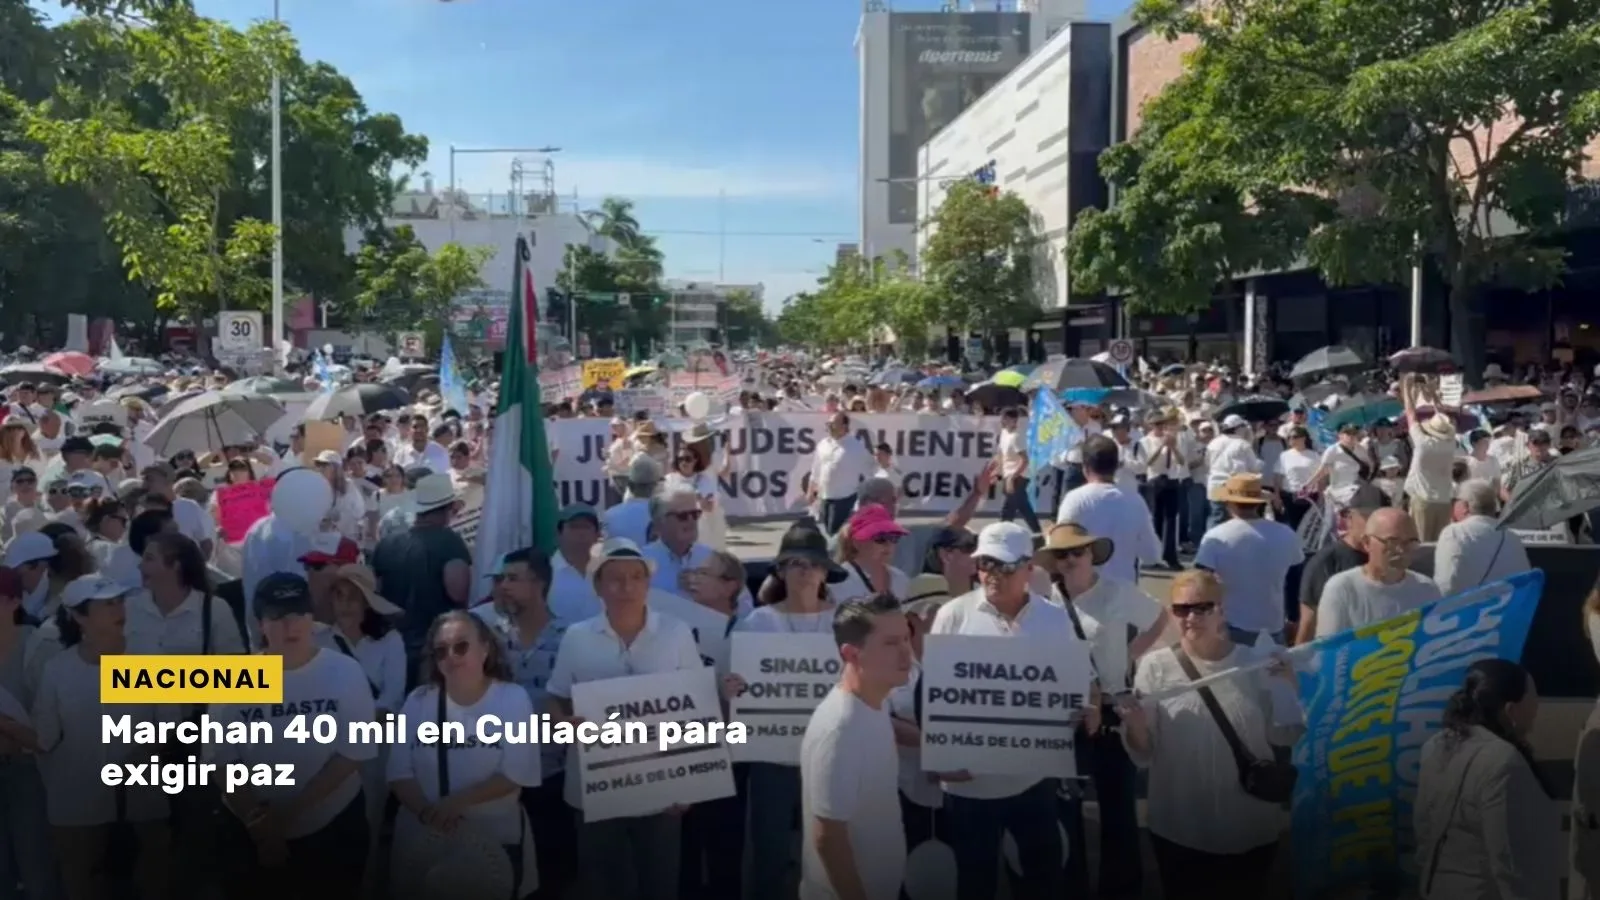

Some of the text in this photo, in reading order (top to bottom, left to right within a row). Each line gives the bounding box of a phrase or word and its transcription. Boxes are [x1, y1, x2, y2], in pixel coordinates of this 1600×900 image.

[231, 320, 251, 337] 30
[760, 658, 840, 674] SINALO
[954, 662, 1058, 682] SINALOA
[604, 695, 695, 720] SINALOA
[928, 687, 1084, 709] PONTE DE PIE
[240, 698, 338, 721] YA BASTA
[758, 724, 789, 737] MÁS
[925, 732, 1074, 751] NO MÁS DE LO MISM
[586, 760, 728, 795] NO MÁS DE LO MISMO
